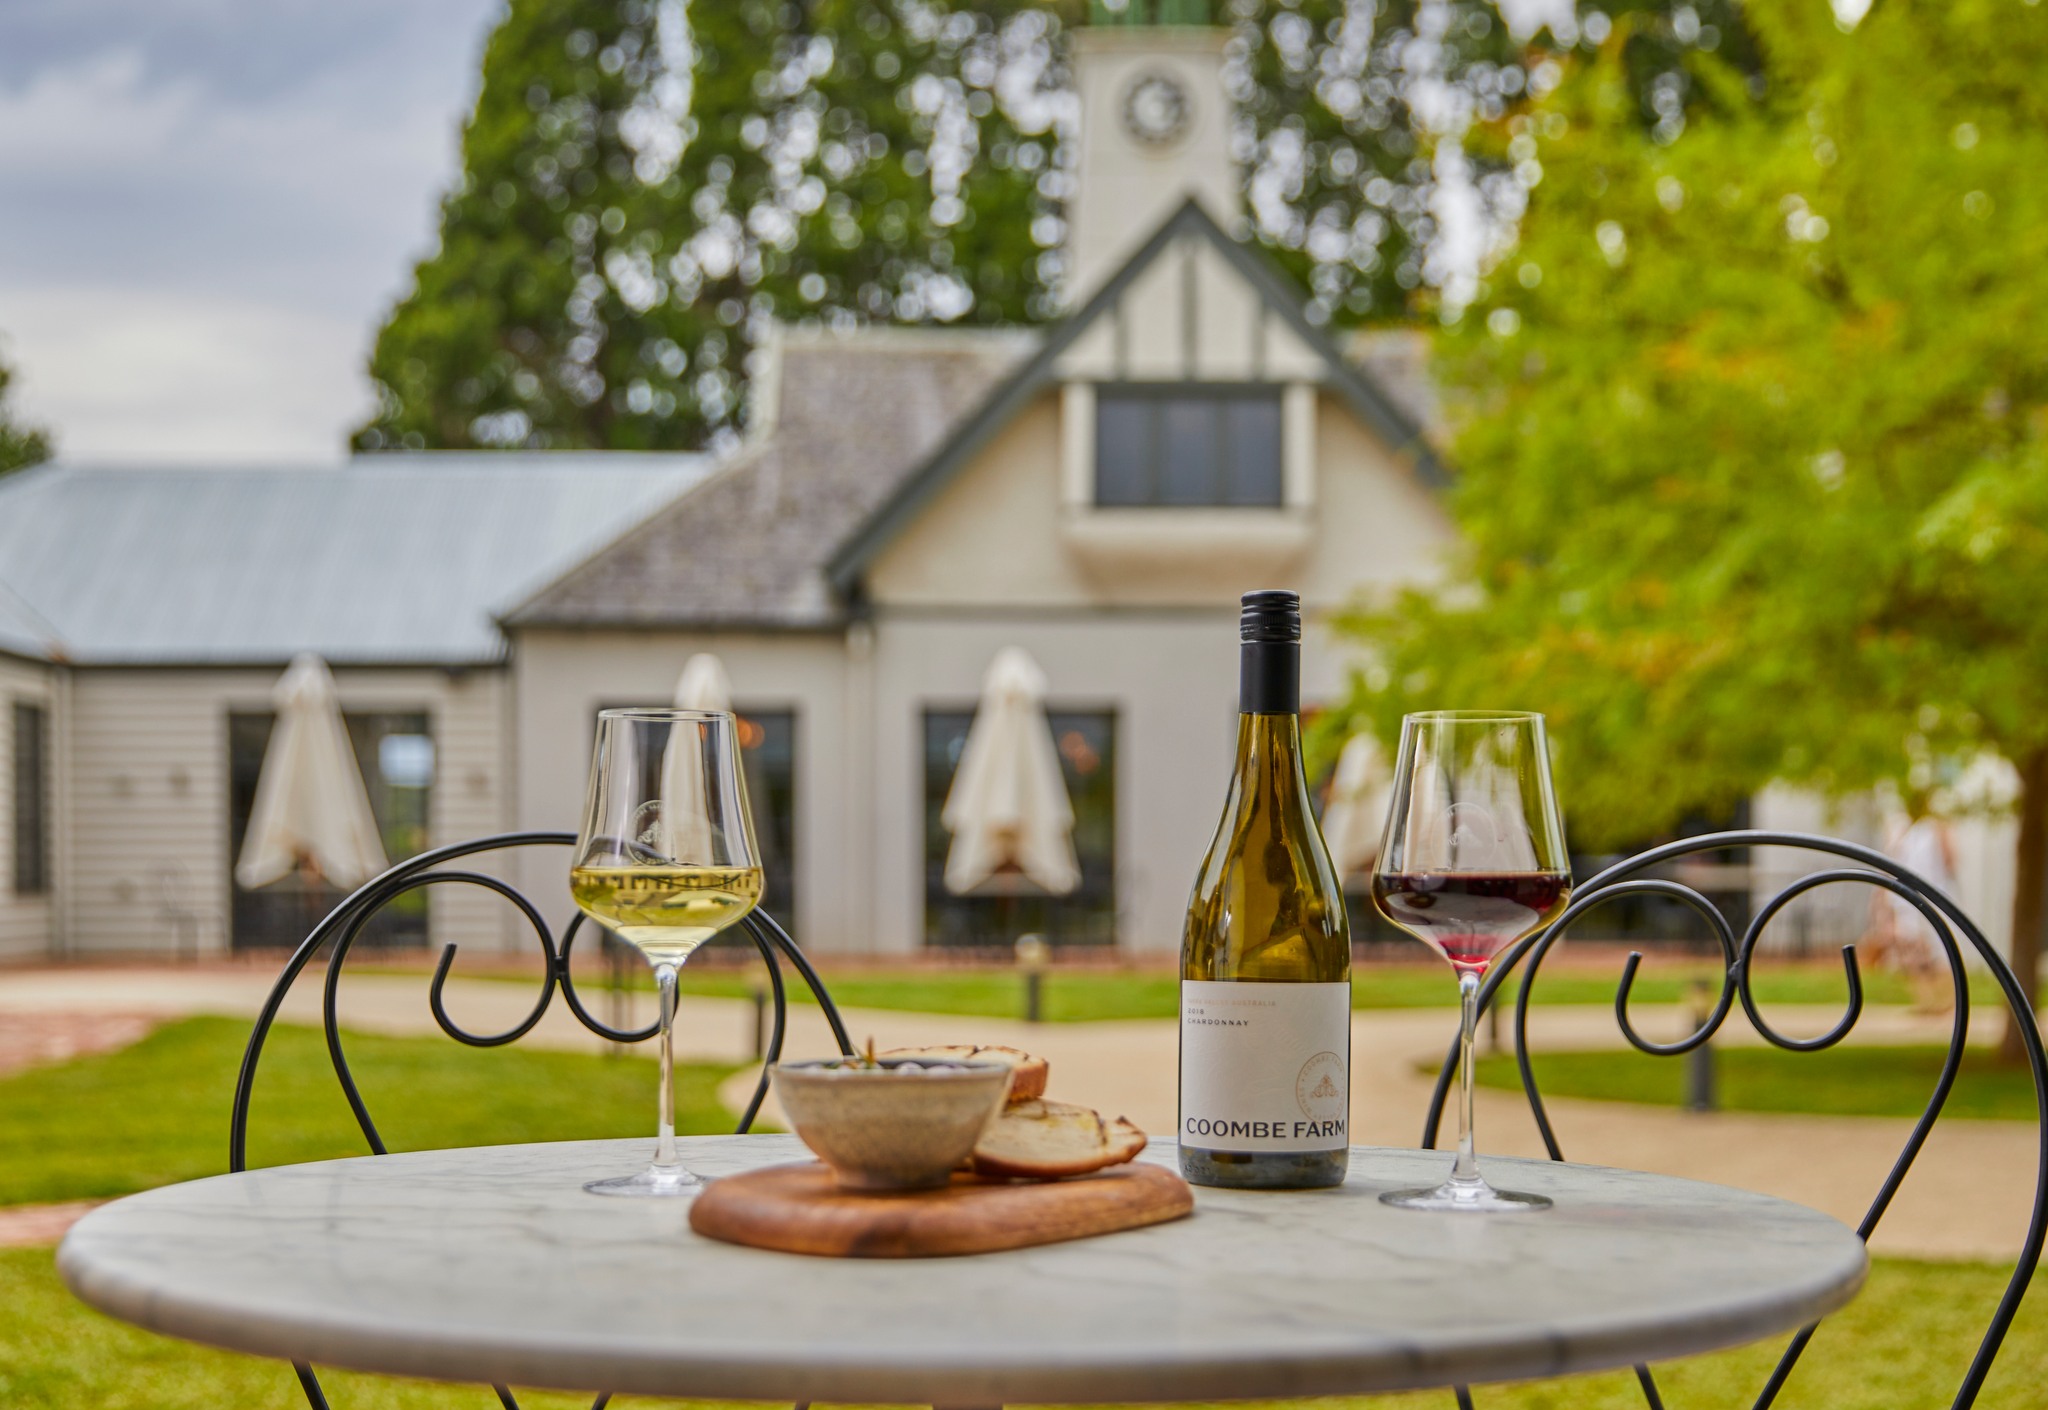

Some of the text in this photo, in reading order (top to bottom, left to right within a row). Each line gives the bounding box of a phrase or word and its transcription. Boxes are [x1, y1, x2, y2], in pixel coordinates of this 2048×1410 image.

[1187, 1018, 1249, 1026] CHARDONNAY
[1186, 1117, 1345, 1138] COOMBE FARM
